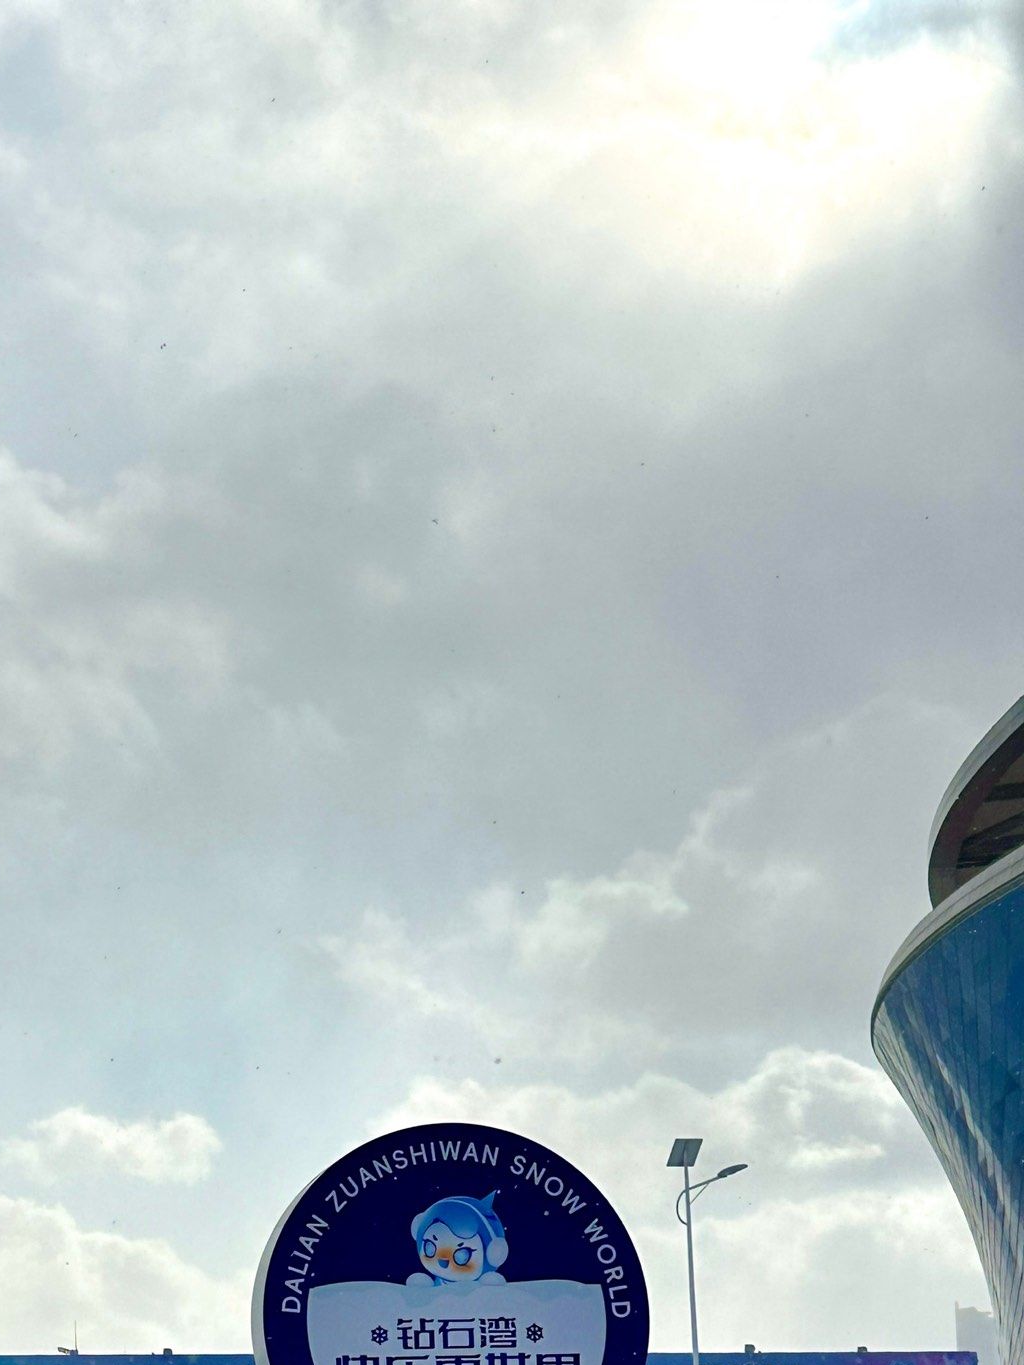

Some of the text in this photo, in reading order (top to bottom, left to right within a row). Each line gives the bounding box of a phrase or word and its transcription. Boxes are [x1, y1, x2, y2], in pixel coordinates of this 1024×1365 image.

[281, 1140, 632, 1319] DALIAN ZUANSHIWAN SNOW WORLD
[396, 1316, 518, 1350] 钻石湾
